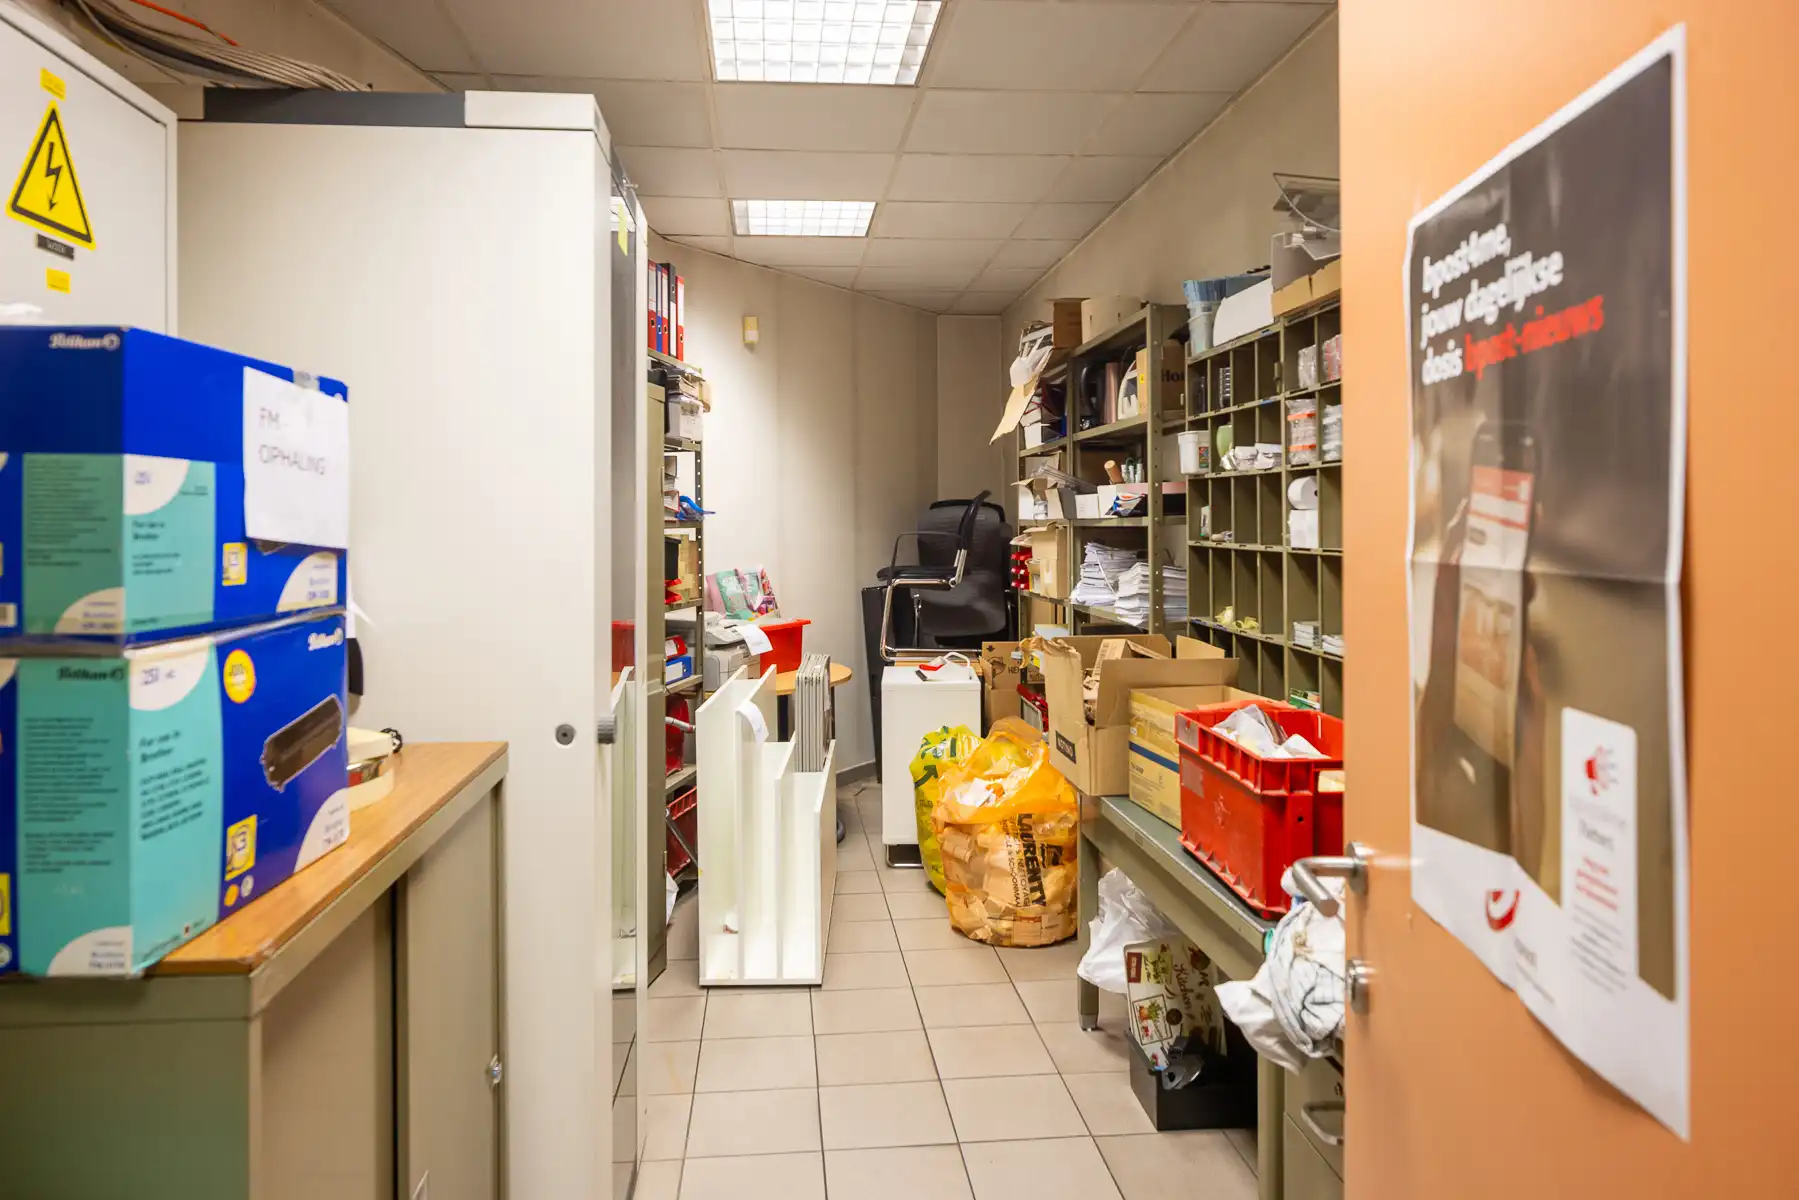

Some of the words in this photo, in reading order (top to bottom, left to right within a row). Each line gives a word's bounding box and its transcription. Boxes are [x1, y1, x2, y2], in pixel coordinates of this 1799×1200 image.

[1420, 302, 1464, 350] jouw
[1464, 251, 1564, 325] dagelijkse
[1421, 339, 1463, 386] dosis
[1464, 295, 1605, 381] bpost-nieuws
[259, 445, 326, 476] OPHALING
[1017, 813, 1047, 907] LAURENTY
